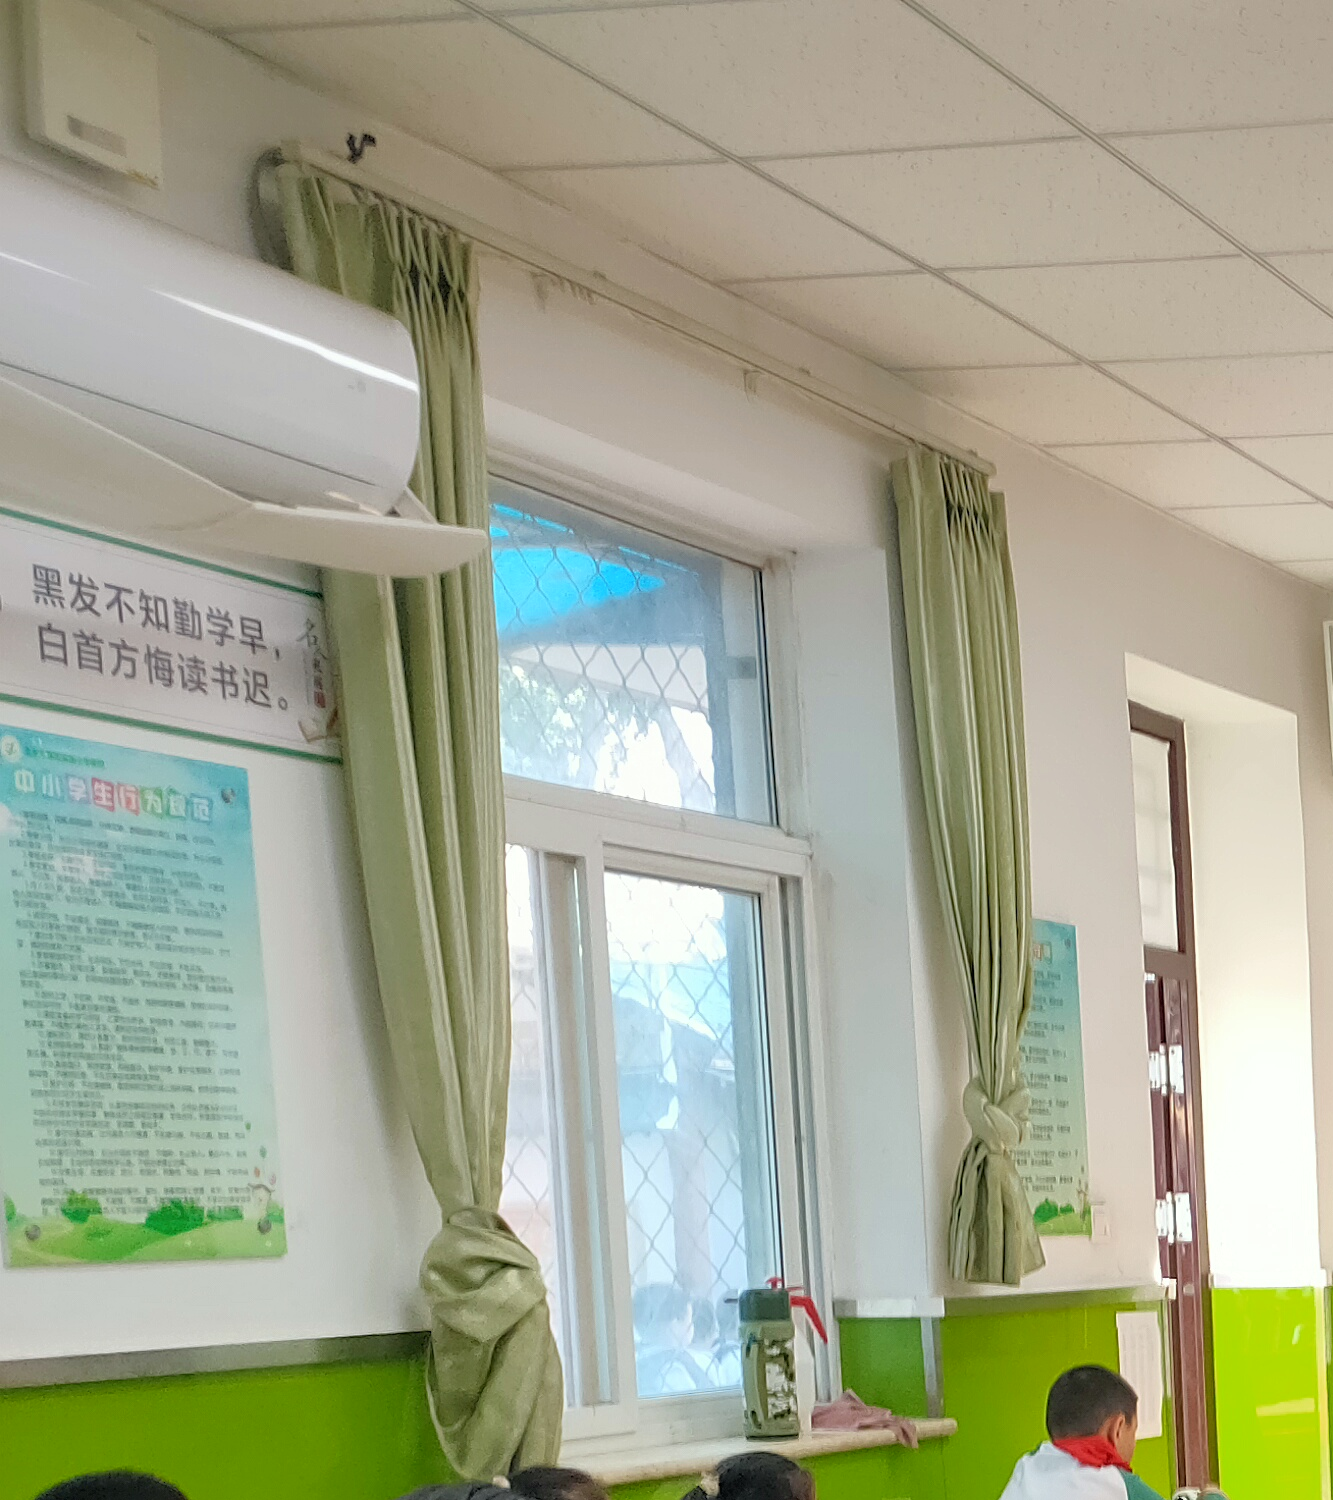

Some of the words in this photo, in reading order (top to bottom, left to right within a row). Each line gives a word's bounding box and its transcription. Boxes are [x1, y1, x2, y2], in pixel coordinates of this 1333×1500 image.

[32, 563, 282, 662] 黑发不知勤学早，
[38, 623, 288, 711] 白首方悔读书迟。
[14, 768, 211, 822] 中小学生行为规范
